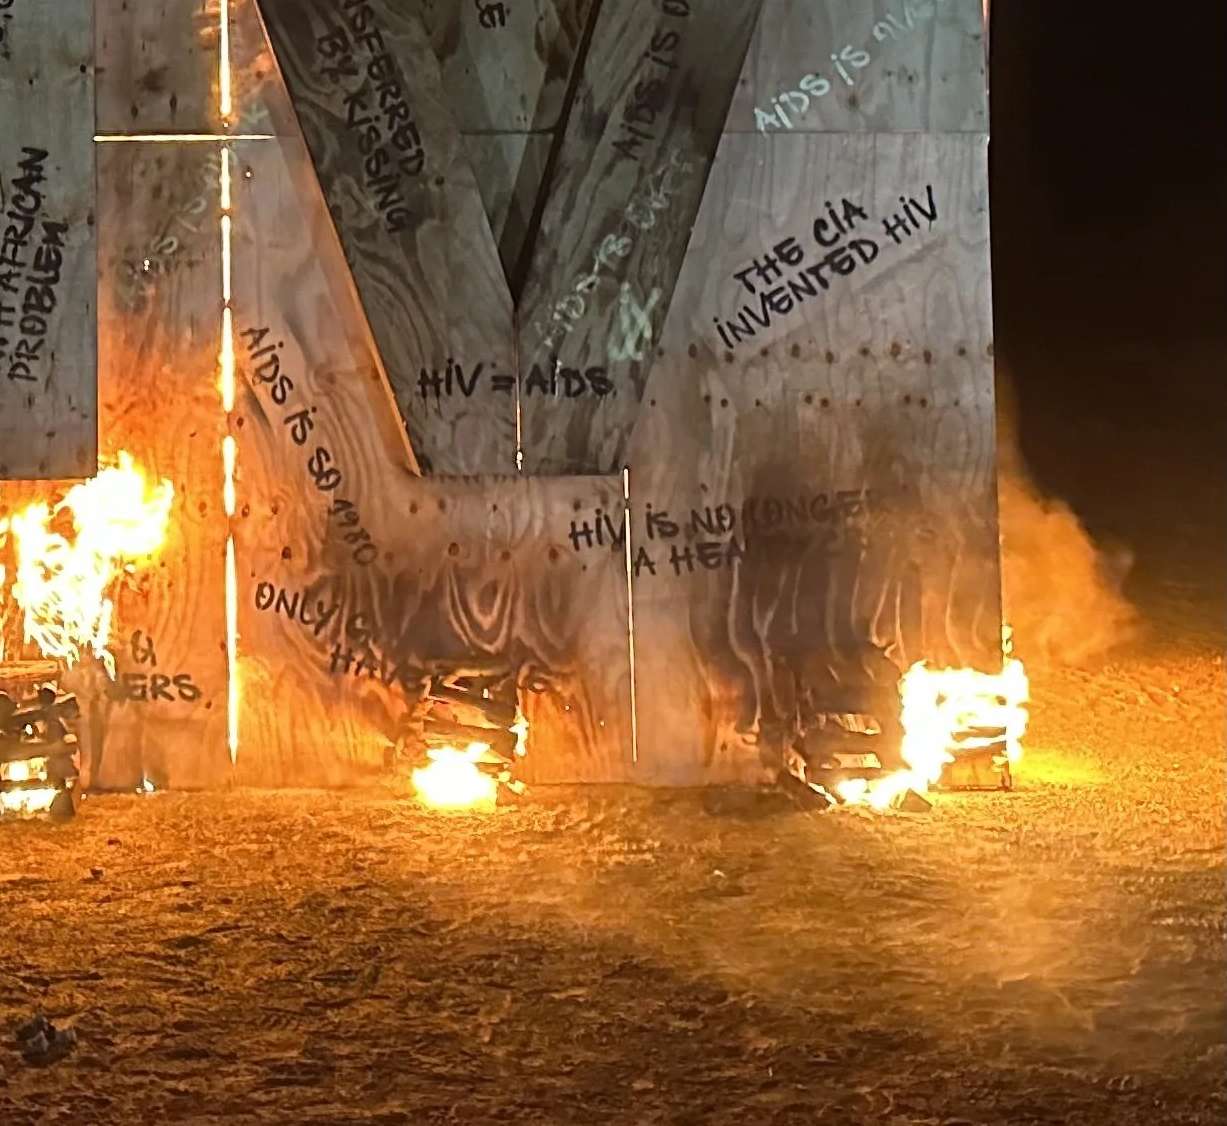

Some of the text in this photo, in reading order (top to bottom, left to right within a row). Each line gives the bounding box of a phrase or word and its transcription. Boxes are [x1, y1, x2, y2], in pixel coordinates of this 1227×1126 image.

[317, 26, 360, 86] BY
[733, 236, 804, 294] THE
[7, 220, 69, 382] PROBLEM
[308, 446, 342, 492] SO
[690, 503, 736, 534] NO
[633, 547, 657, 577] A
[255, 582, 340, 637] ONLY
